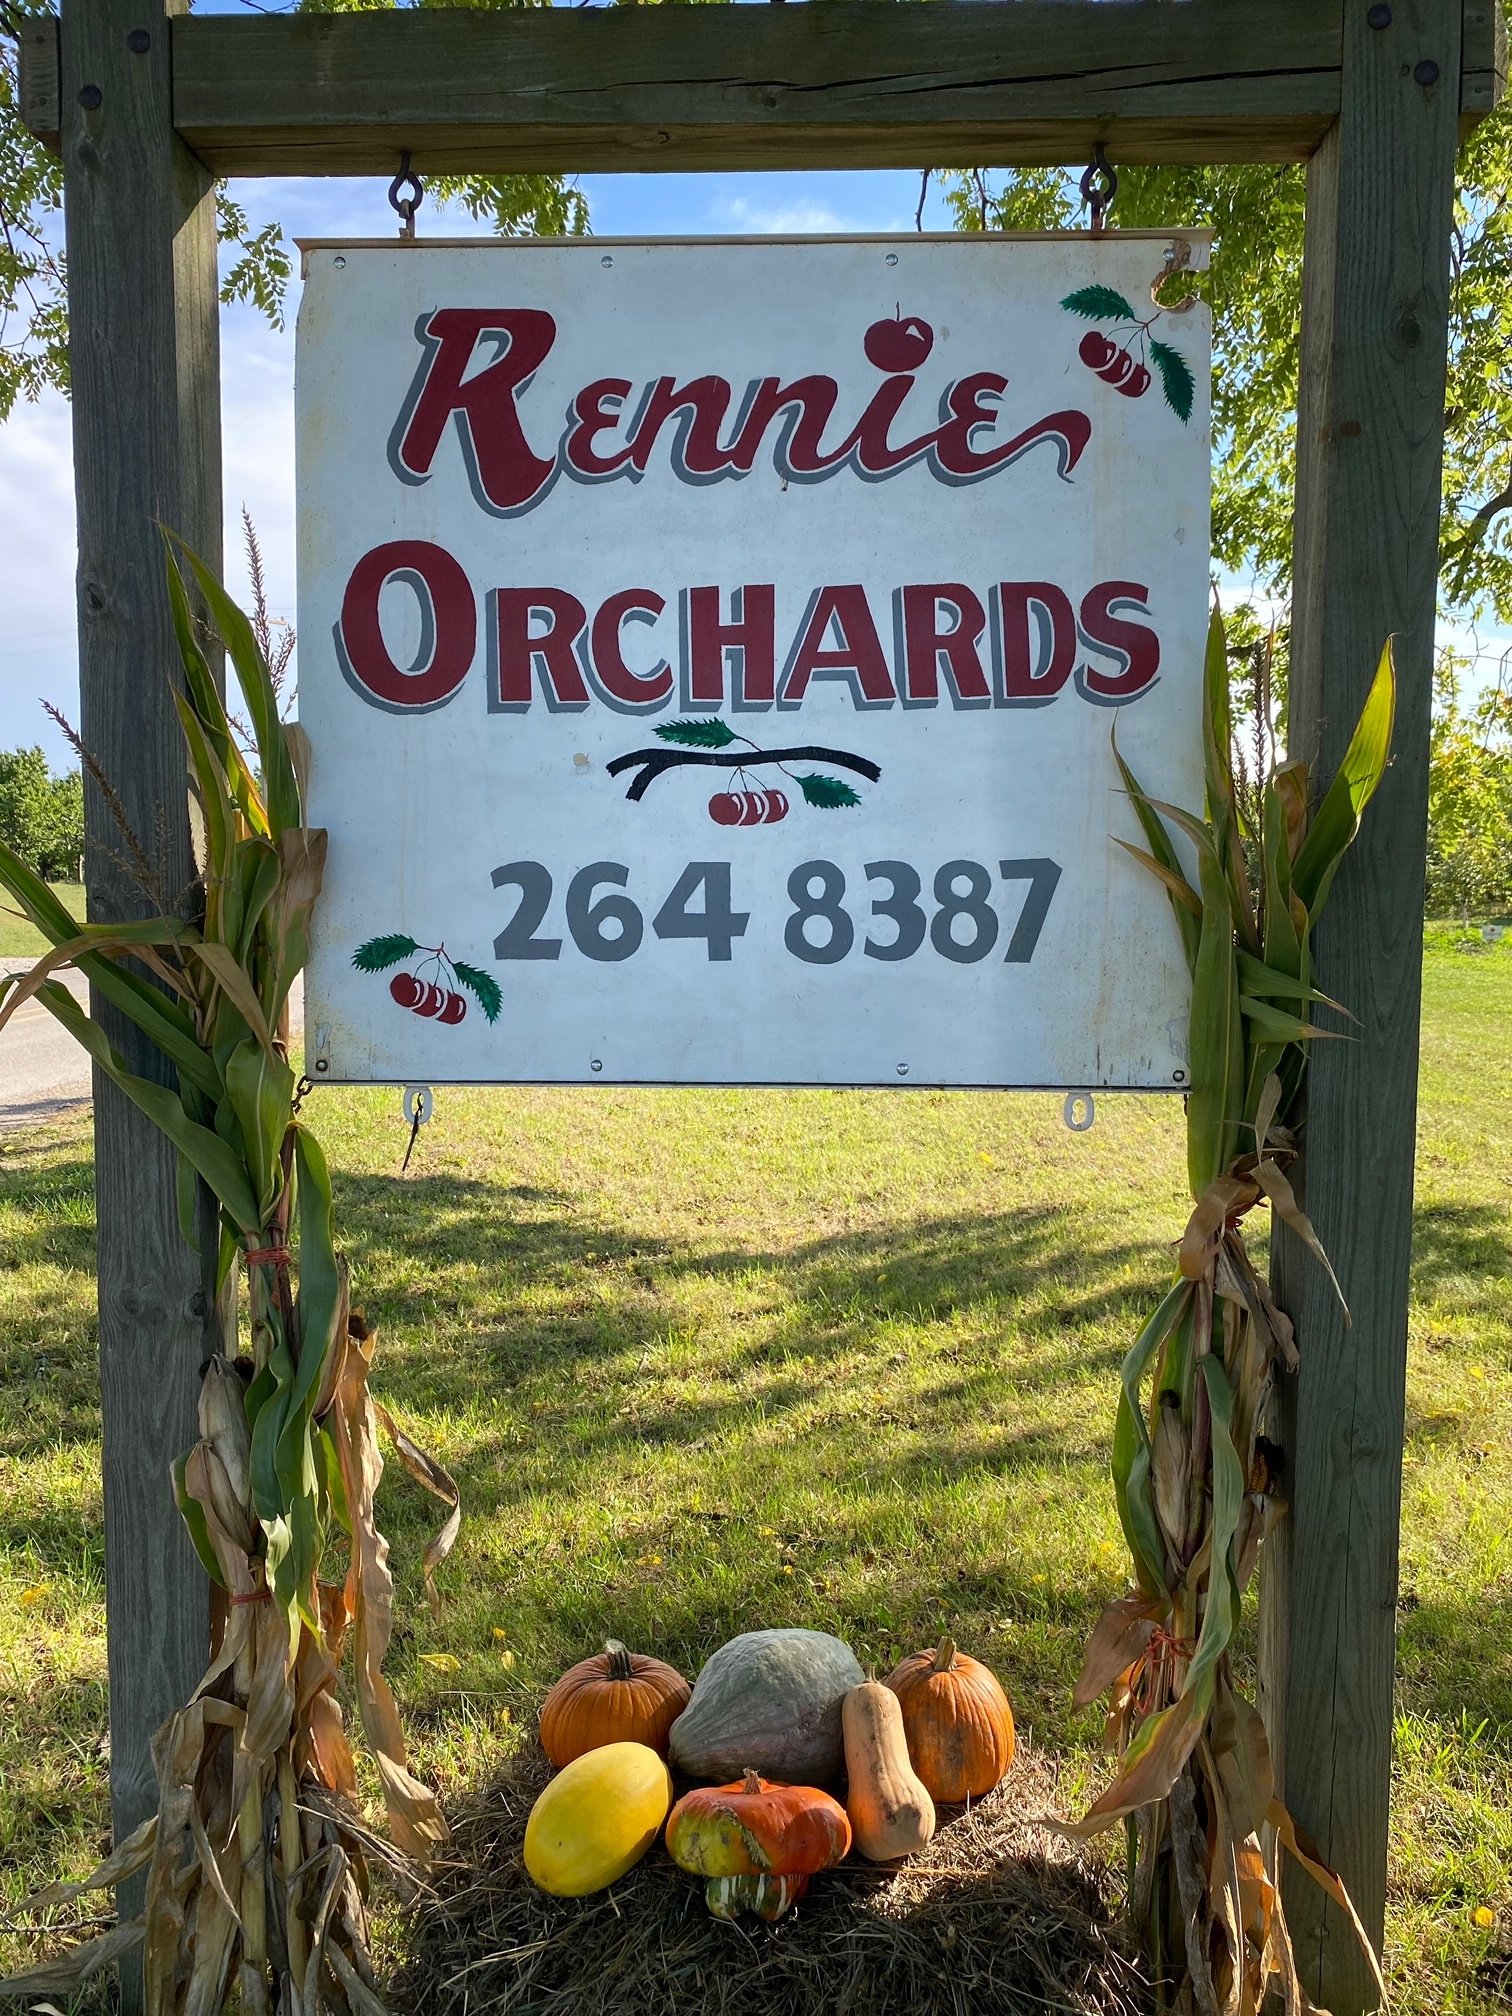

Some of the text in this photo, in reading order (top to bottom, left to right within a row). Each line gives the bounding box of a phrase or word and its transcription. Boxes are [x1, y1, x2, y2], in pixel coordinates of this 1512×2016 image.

[388, 304, 1091, 517] Rennie
[333, 541, 1161, 713] ORCHARDS
[491, 857, 1062, 963] 264 8387
